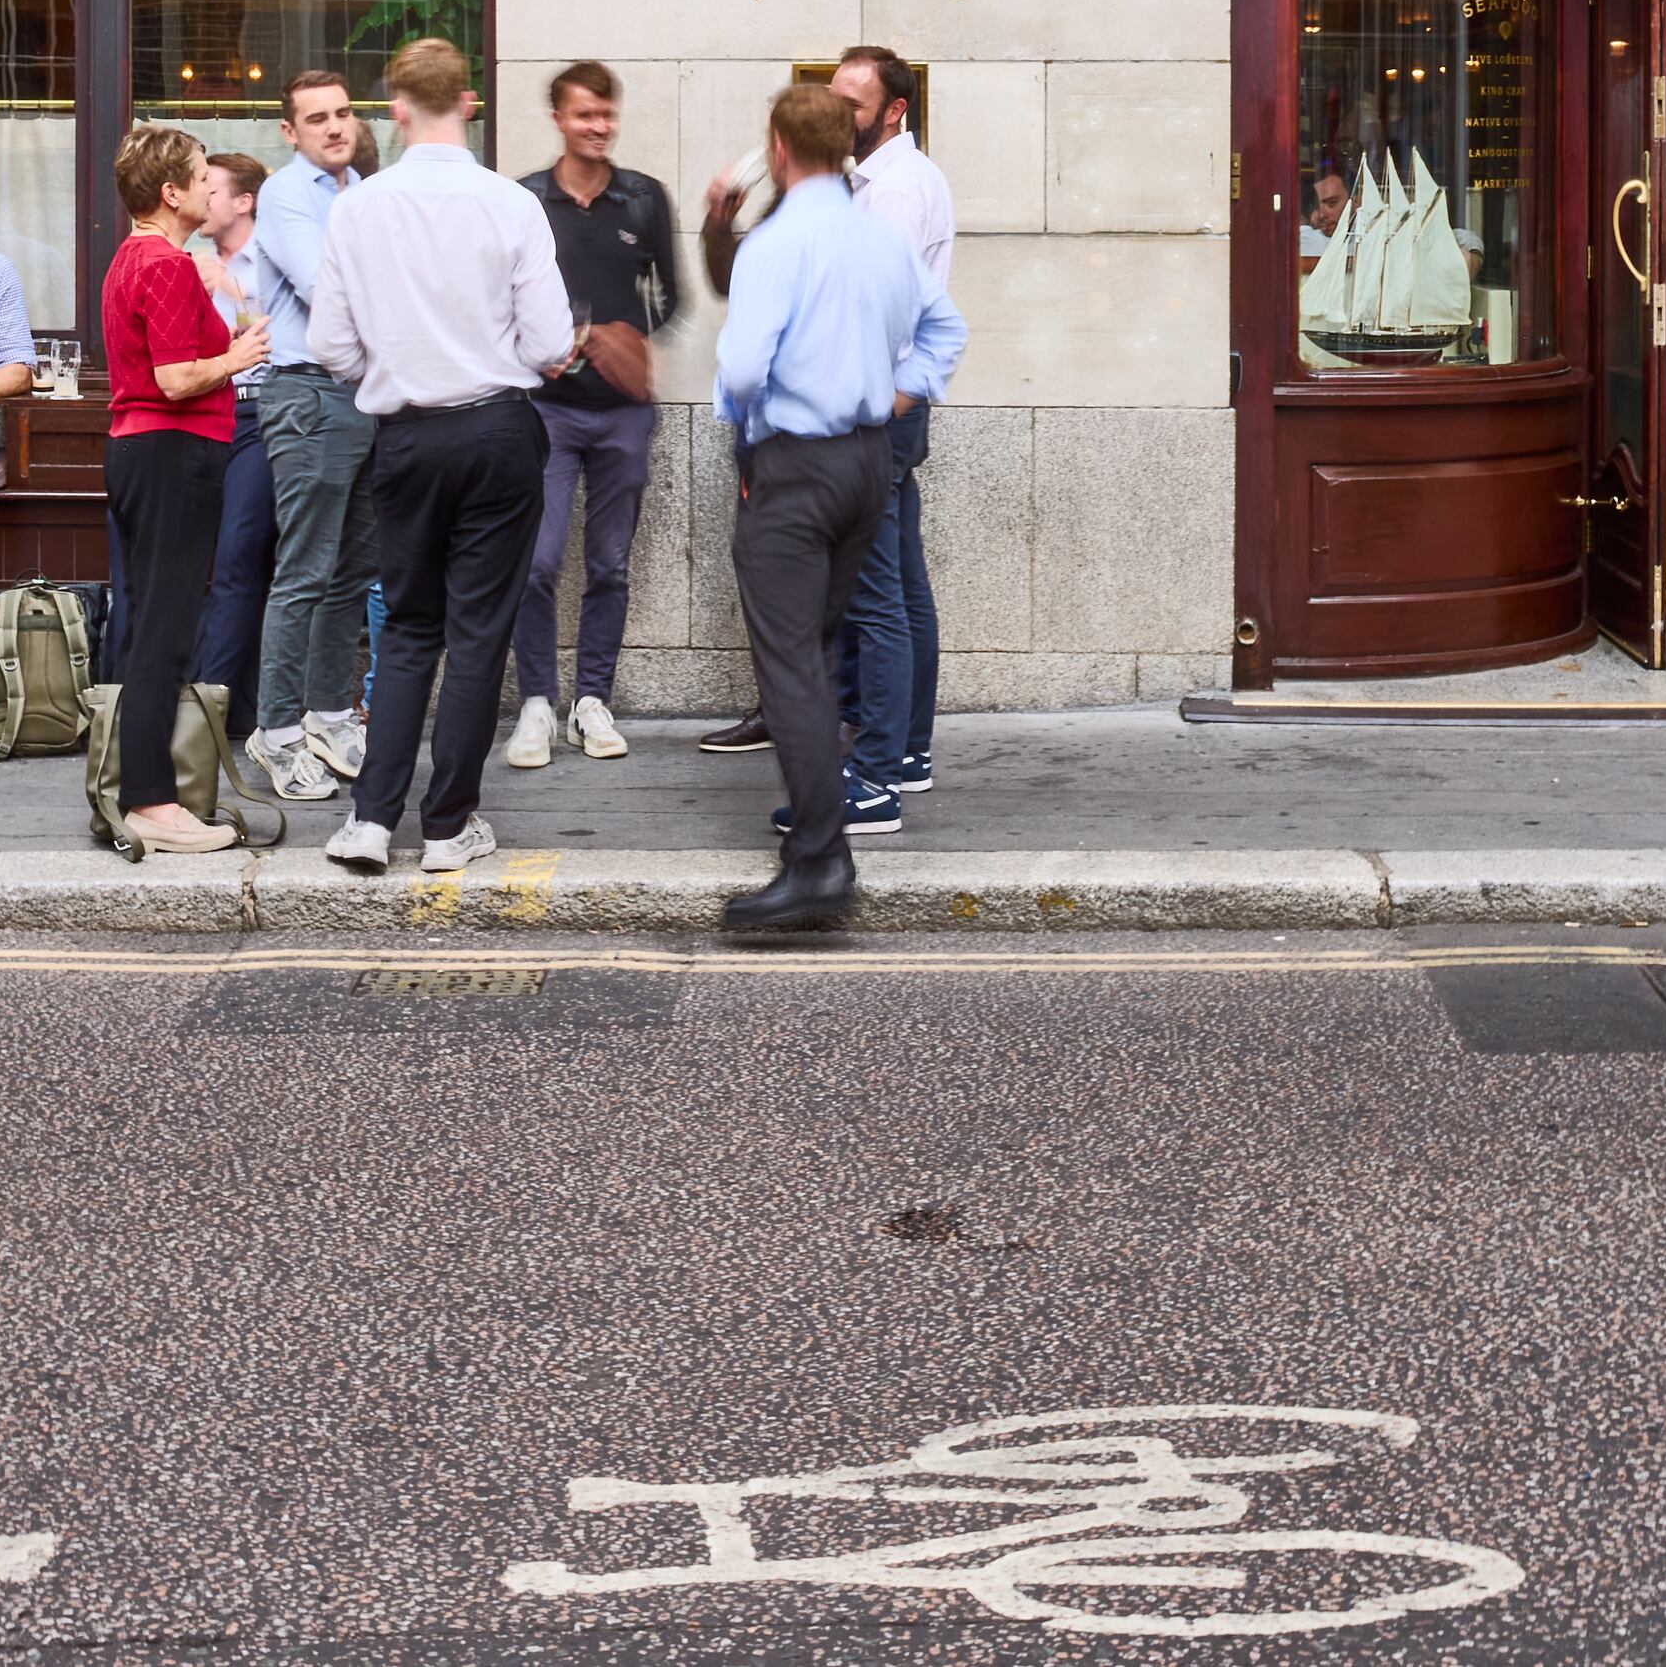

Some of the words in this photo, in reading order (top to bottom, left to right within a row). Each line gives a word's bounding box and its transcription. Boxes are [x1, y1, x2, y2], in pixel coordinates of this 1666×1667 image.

[1468, 54, 1493, 66] LIVE
[1480, 85, 1504, 97] KING
[1464, 117, 1502, 128] NATIVE
